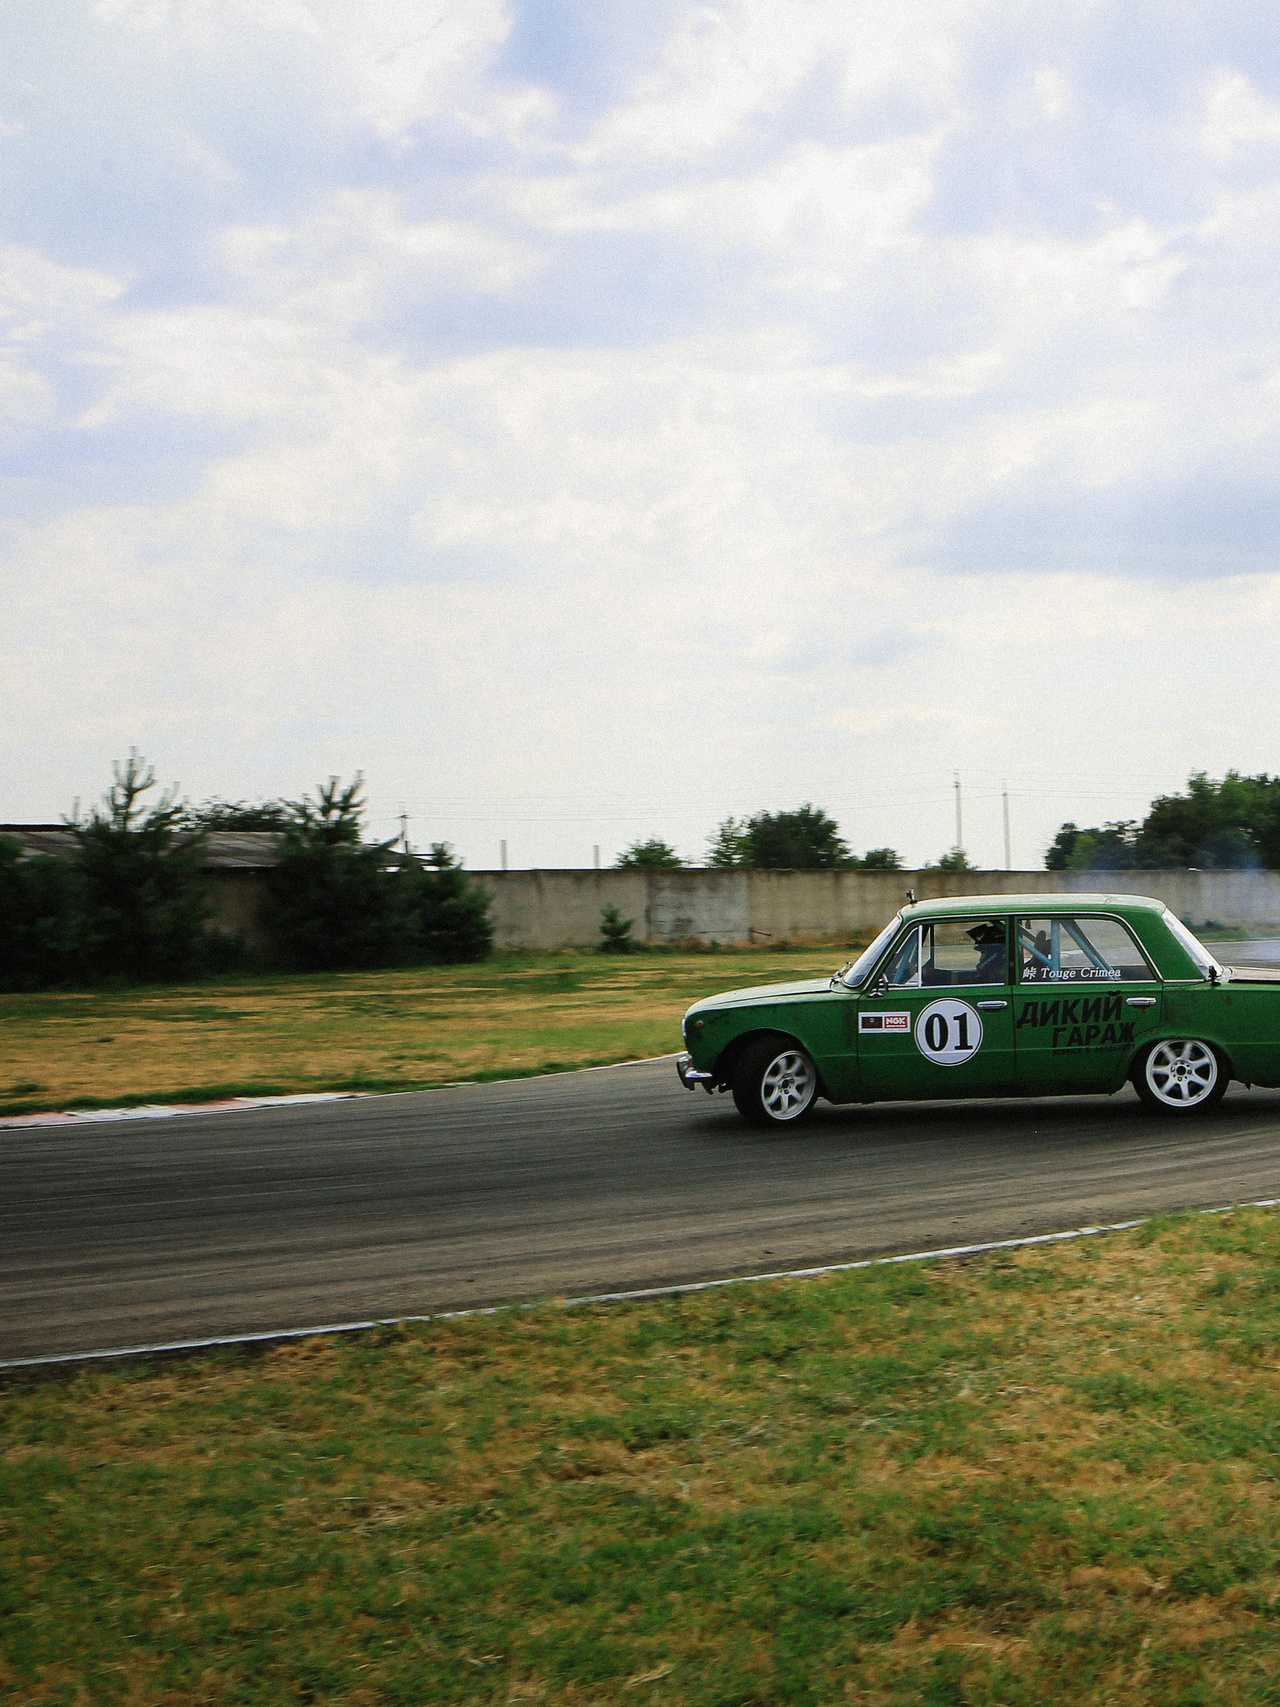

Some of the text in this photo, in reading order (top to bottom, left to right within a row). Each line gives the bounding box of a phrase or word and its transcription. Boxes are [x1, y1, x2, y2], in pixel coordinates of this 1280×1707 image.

[1023, 967, 1037, 979] 峠
[1041, 967, 1121, 979] Touge Crimea
[1017, 990, 1123, 1029] ДИКИЙ
[886, 1017, 906, 1025] NGK
[925, 1013, 973, 1052] 01
[1052, 1022, 1136, 1048] ГАРАЖ
